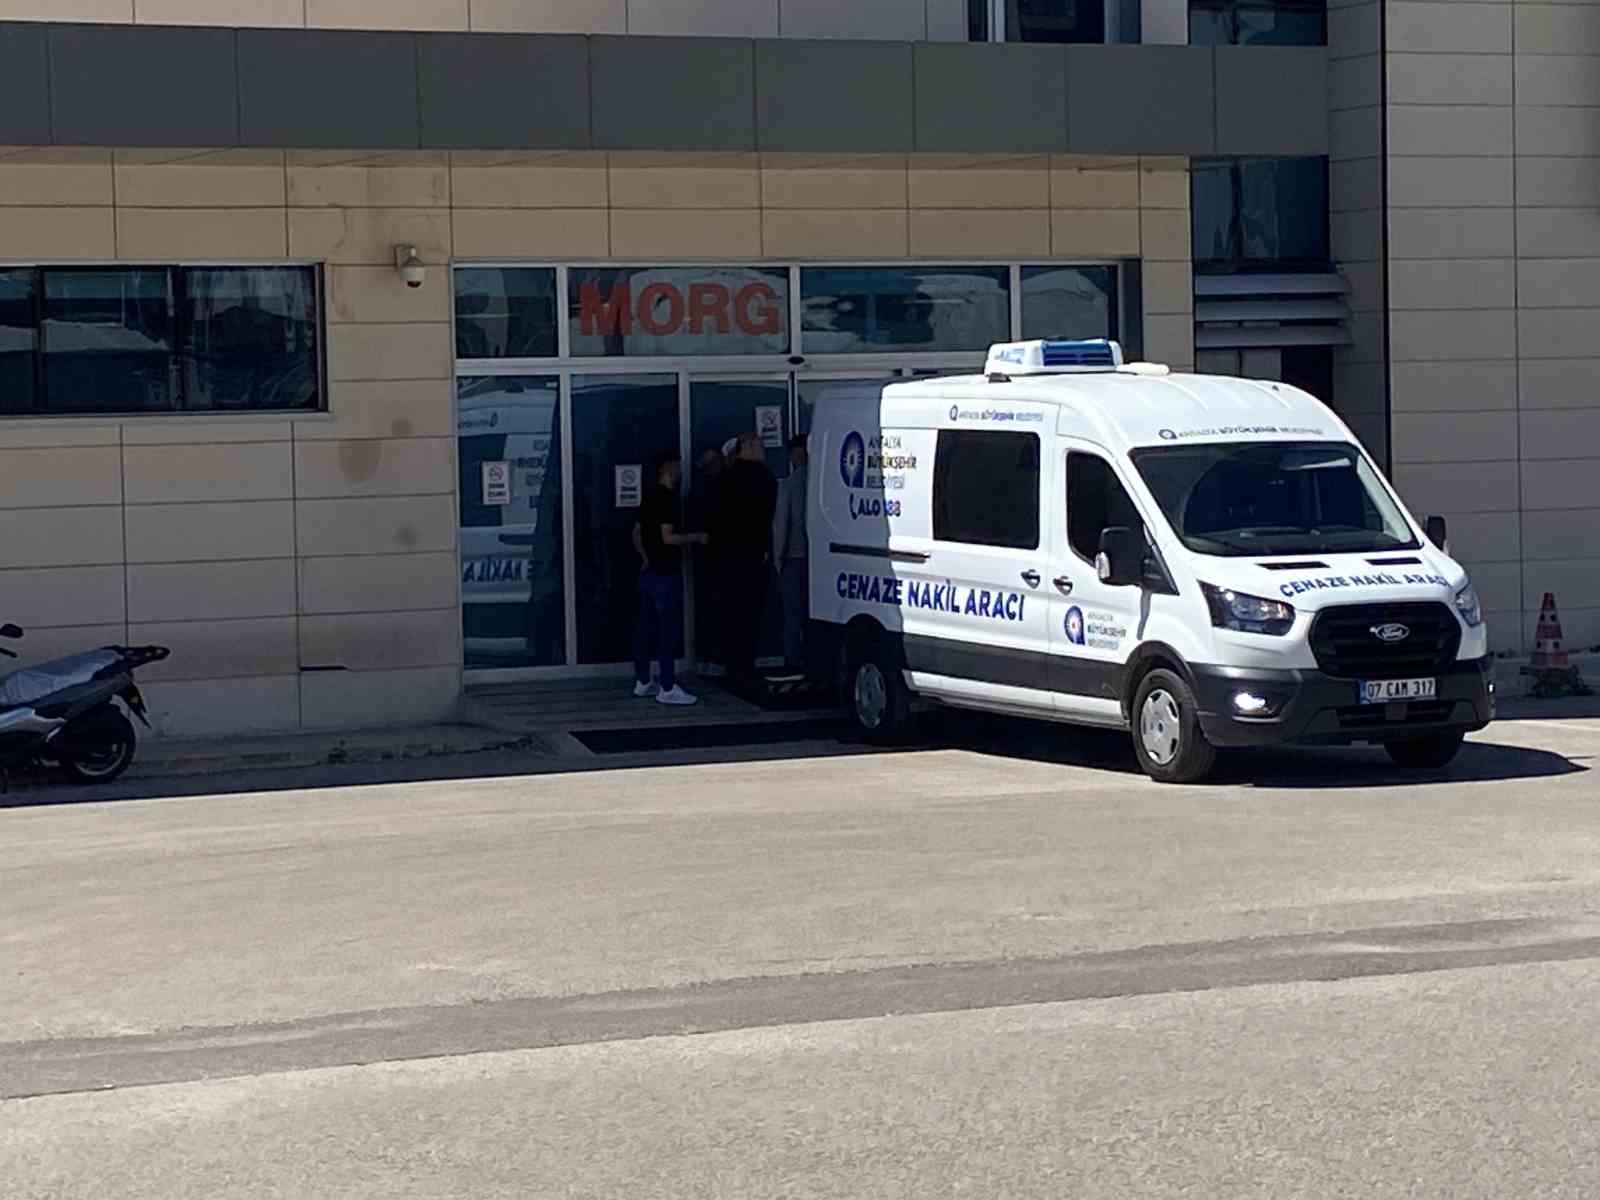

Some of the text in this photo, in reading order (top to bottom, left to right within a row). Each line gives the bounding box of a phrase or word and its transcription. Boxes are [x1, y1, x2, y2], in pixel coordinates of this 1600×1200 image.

[578, 280, 779, 336] MORG
[858, 497, 881, 516] ALO
[836, 572, 1025, 621] CENAZE NAKİL ARACI
[1280, 576, 1350, 597] CENAZE
[1350, 572, 1401, 588] NAKİL
[1367, 680, 1434, 698] 07 CAM 317
